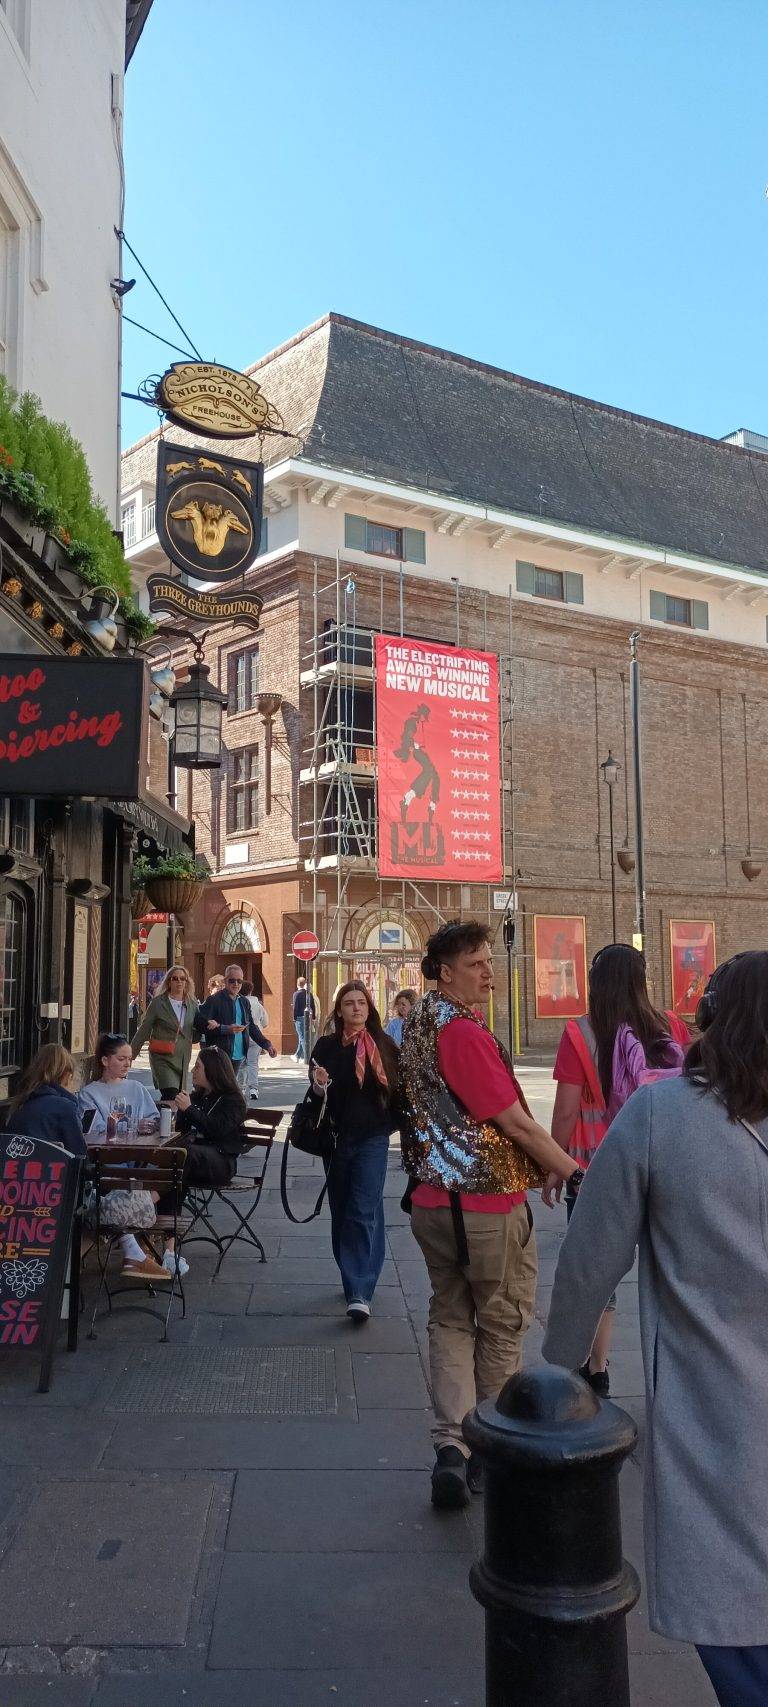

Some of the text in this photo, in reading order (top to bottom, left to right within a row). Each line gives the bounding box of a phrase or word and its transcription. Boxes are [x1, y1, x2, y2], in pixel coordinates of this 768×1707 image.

[175, 384, 259, 416] NICHOLSON'S
[192, 405, 242, 422] FREEHOUSE
[153, 585, 260, 616] THREE GREYHOUNDS
[197, 593, 218, 604] THE
[385, 645, 490, 673] THE ELECTRIFYING
[385, 659, 490, 687] AWARD-WINNING
[385, 672, 490, 703] NEW MUSICAL
[17, 701, 42, 724] &
[397, 822, 438, 857] MJ
[0, 1180, 62, 1207] OING
[0, 1323, 40, 1345] IN
